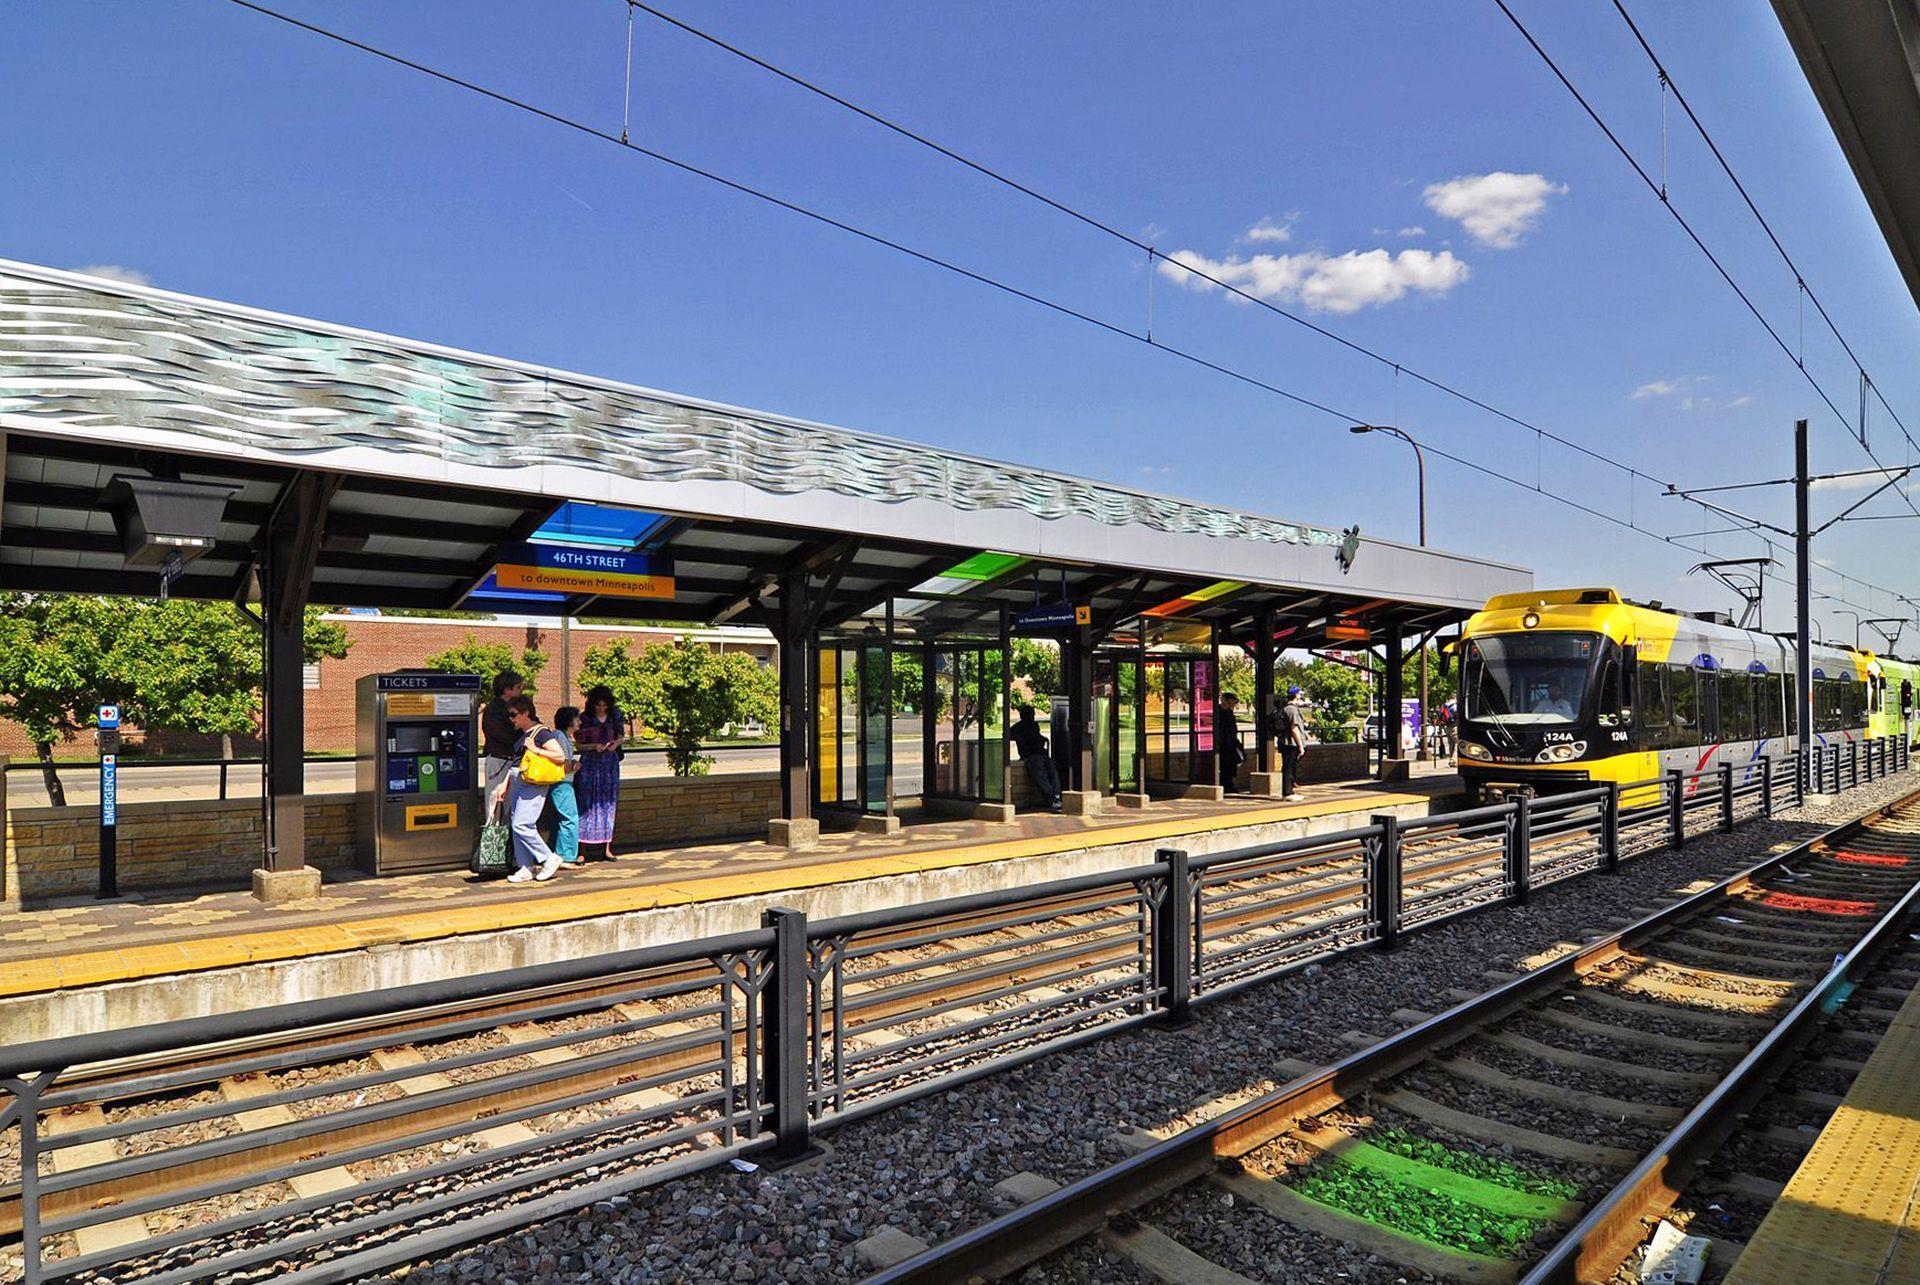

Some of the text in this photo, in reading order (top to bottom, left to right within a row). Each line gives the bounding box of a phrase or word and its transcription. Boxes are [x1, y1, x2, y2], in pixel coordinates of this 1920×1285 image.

[553, 552, 626, 568] 46TH STREET
[520, 573, 656, 592] to downtown Minneapolis
[383, 678, 428, 687] TICKETS
[1546, 732, 1574, 741] 124A
[1611, 731, 1628, 741] 124A
[103, 767, 114, 826] EMERGENCY
